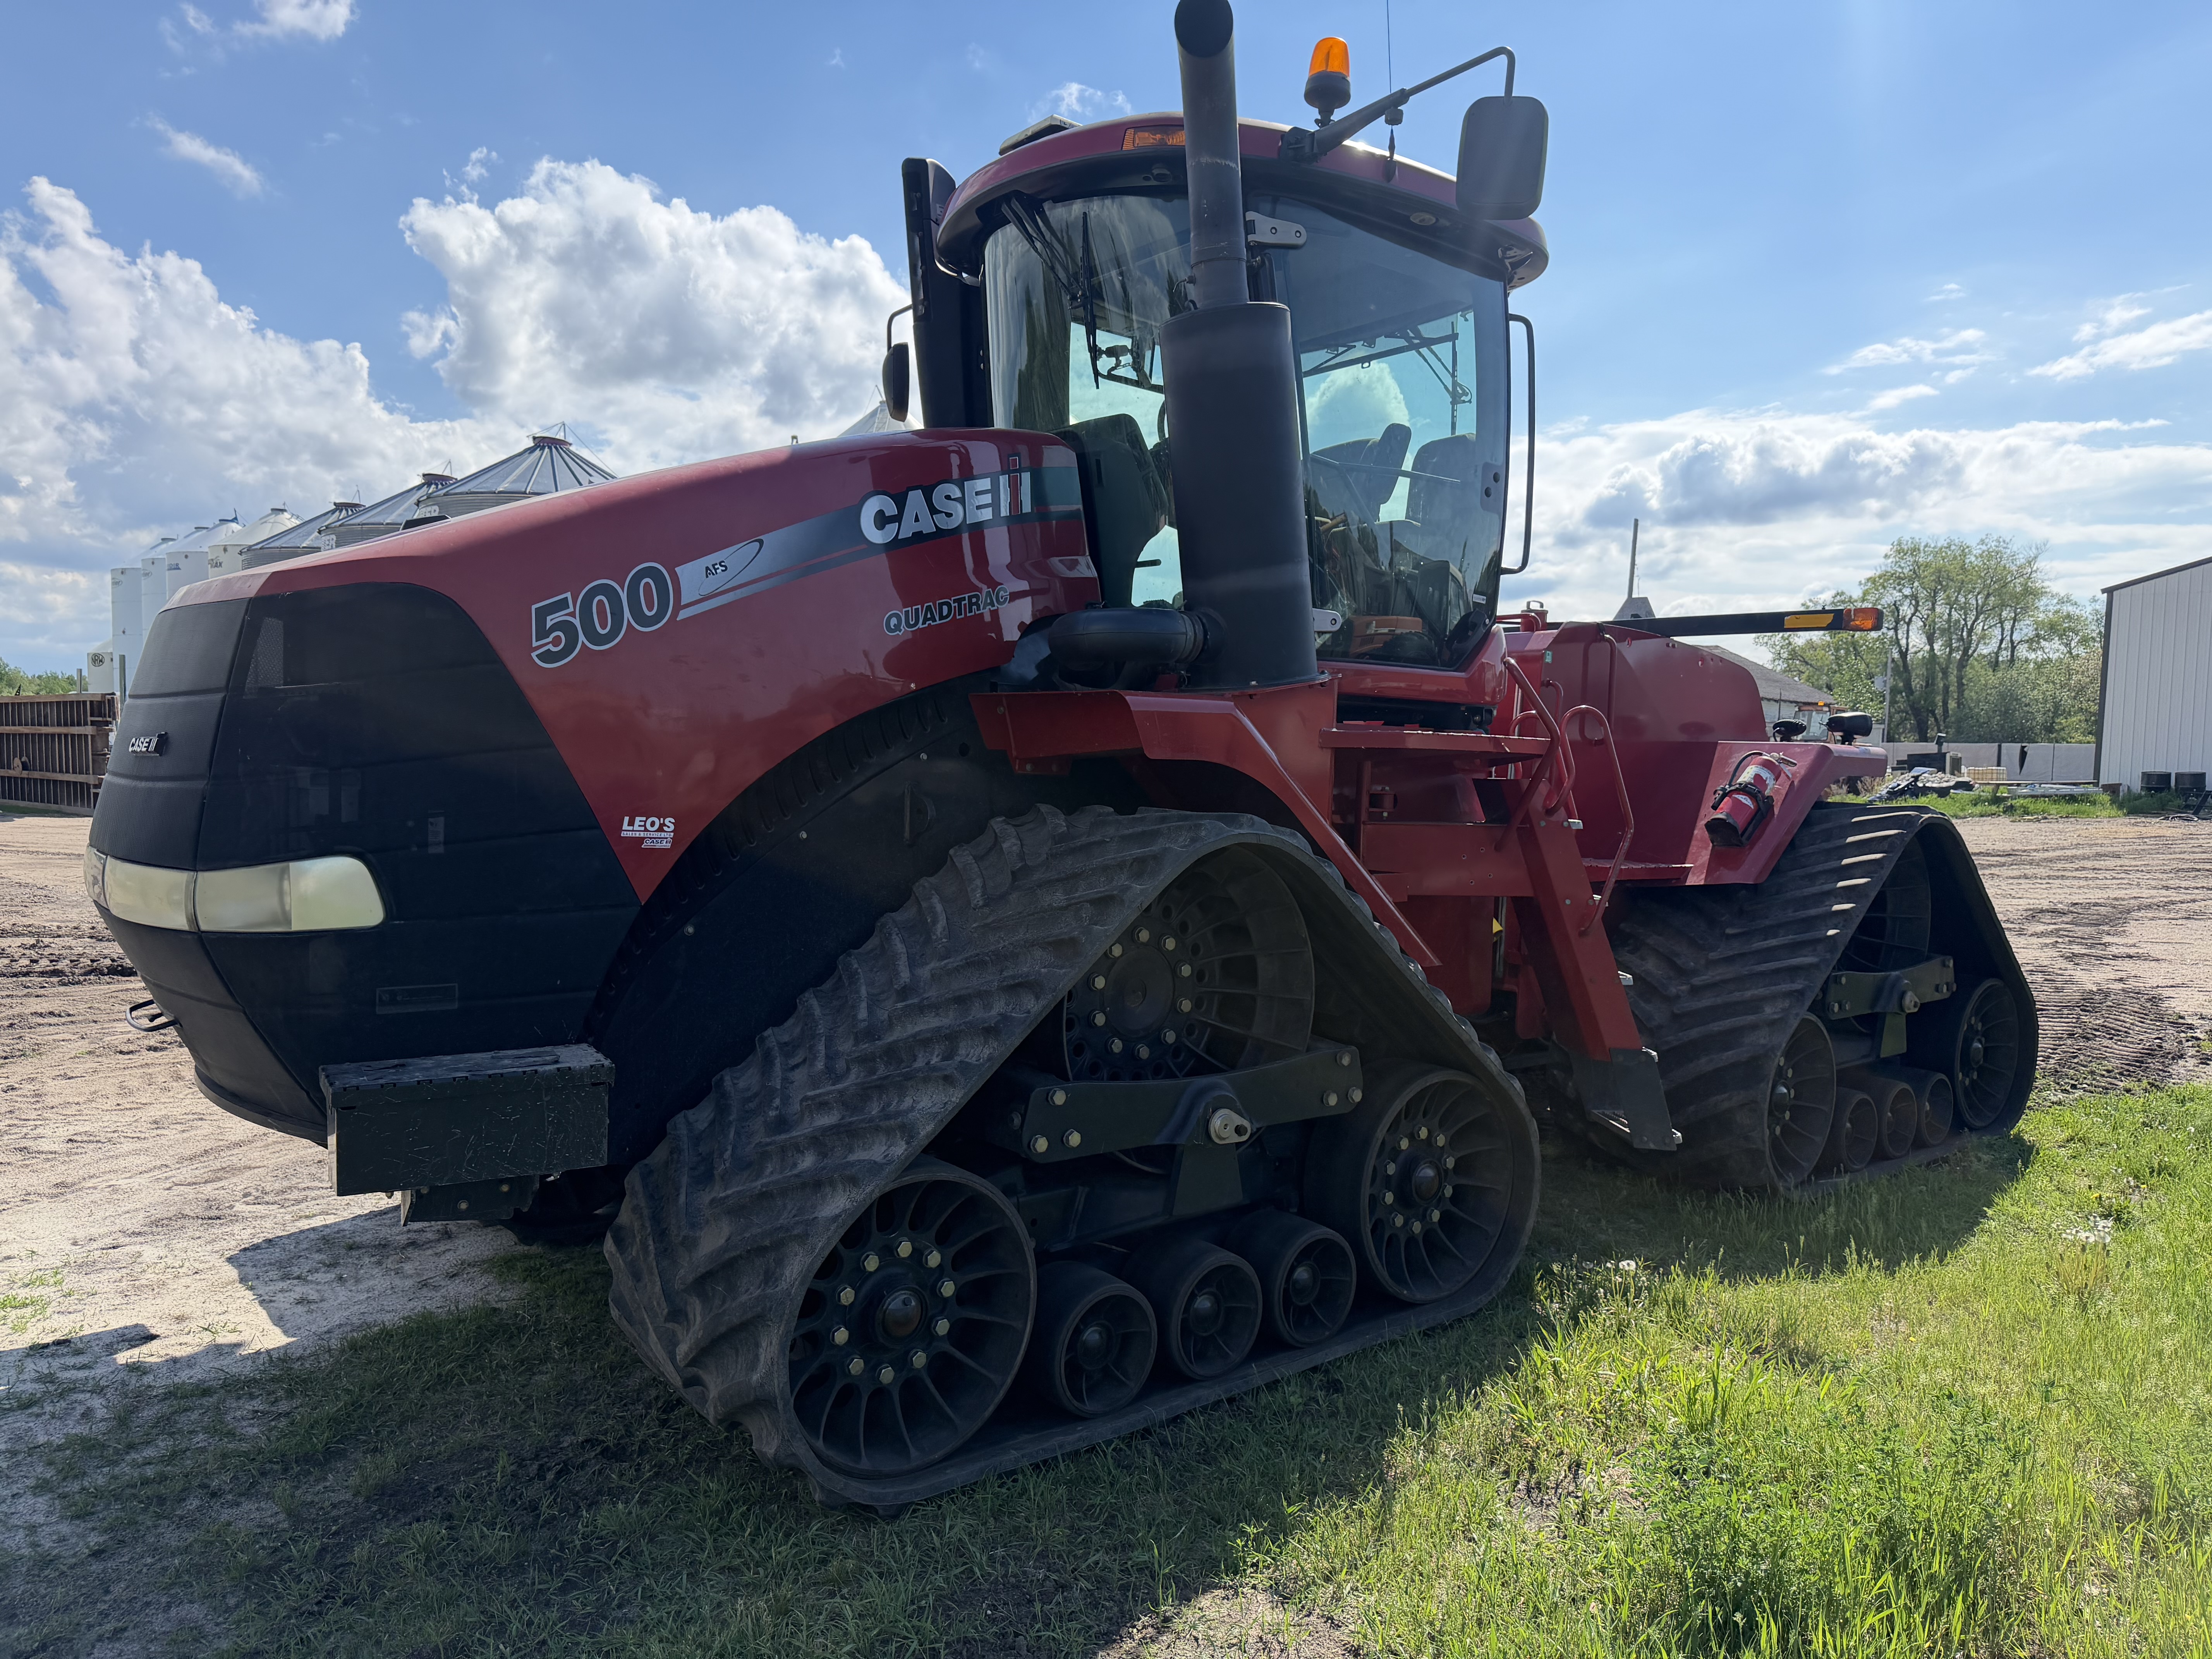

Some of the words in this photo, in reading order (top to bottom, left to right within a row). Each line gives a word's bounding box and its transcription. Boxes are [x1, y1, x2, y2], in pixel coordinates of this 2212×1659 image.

[860, 477, 993, 544] CASE
[705, 560, 728, 578] AFS
[531, 562, 673, 668] 500
[883, 585, 1010, 635] QUADTRAC
[129, 737, 150, 752] CASE
[622, 816, 675, 832] LEO'S
